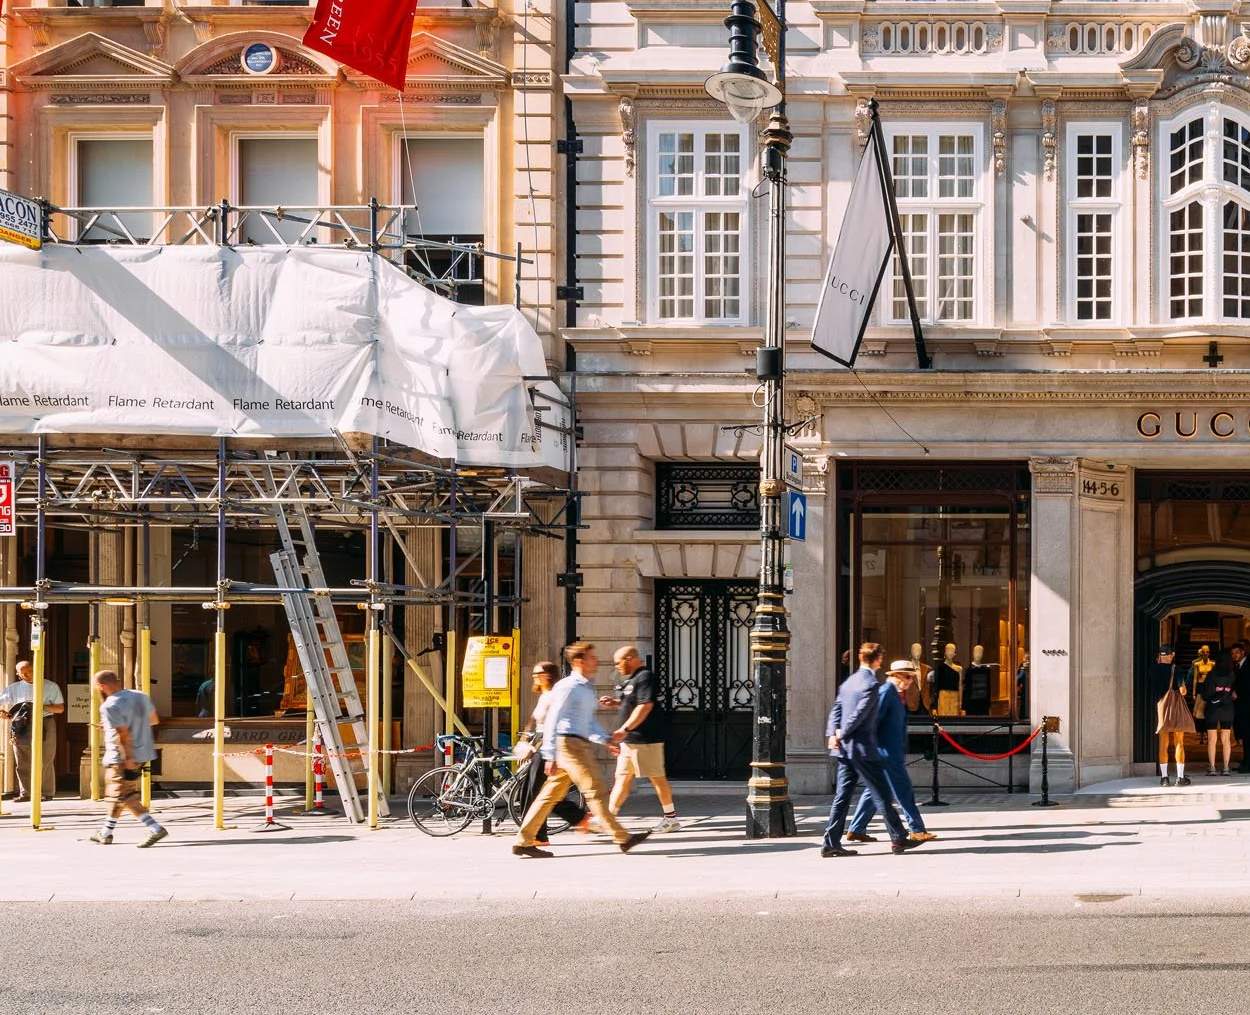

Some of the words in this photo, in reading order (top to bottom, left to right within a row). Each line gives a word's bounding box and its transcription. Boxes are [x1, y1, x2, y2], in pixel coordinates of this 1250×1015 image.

[33, 394, 89, 407] Retardant
[108, 395, 147, 408] Flame
[152, 397, 215, 410] Retardant
[233, 398, 270, 410] Flame
[275, 398, 335, 410] Retardant
[385, 400, 424, 427] Retardant
[458, 431, 503, 442] Retardant
